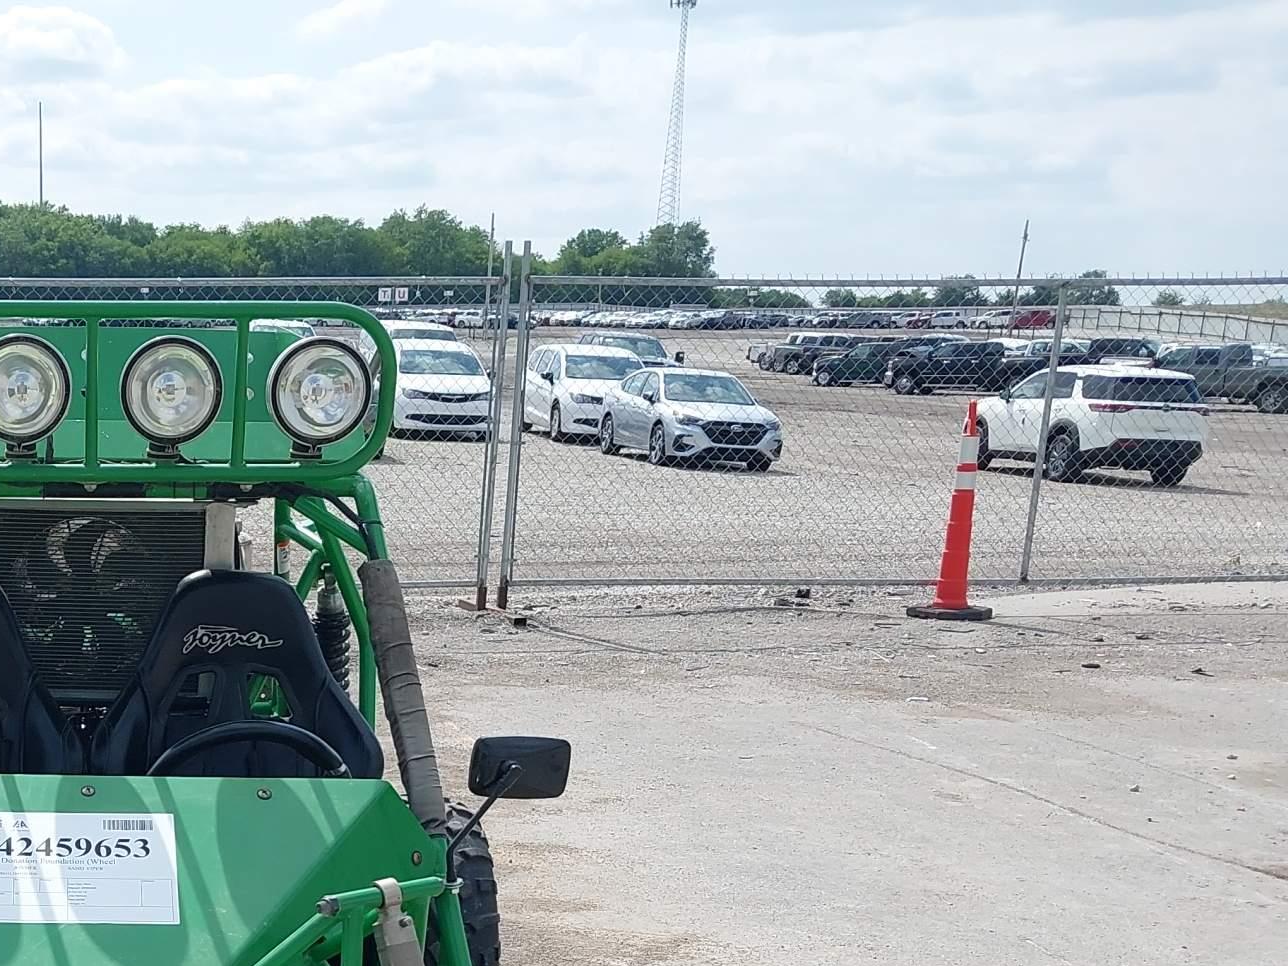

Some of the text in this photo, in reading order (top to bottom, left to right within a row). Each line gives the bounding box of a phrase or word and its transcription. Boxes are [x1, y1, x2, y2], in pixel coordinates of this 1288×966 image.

[398, 290, 406, 299] U
[1, 857, 38, 865] Donation
[40, 858, 86, 866] Foundation
[86, 858, 116, 866] (Wheel
